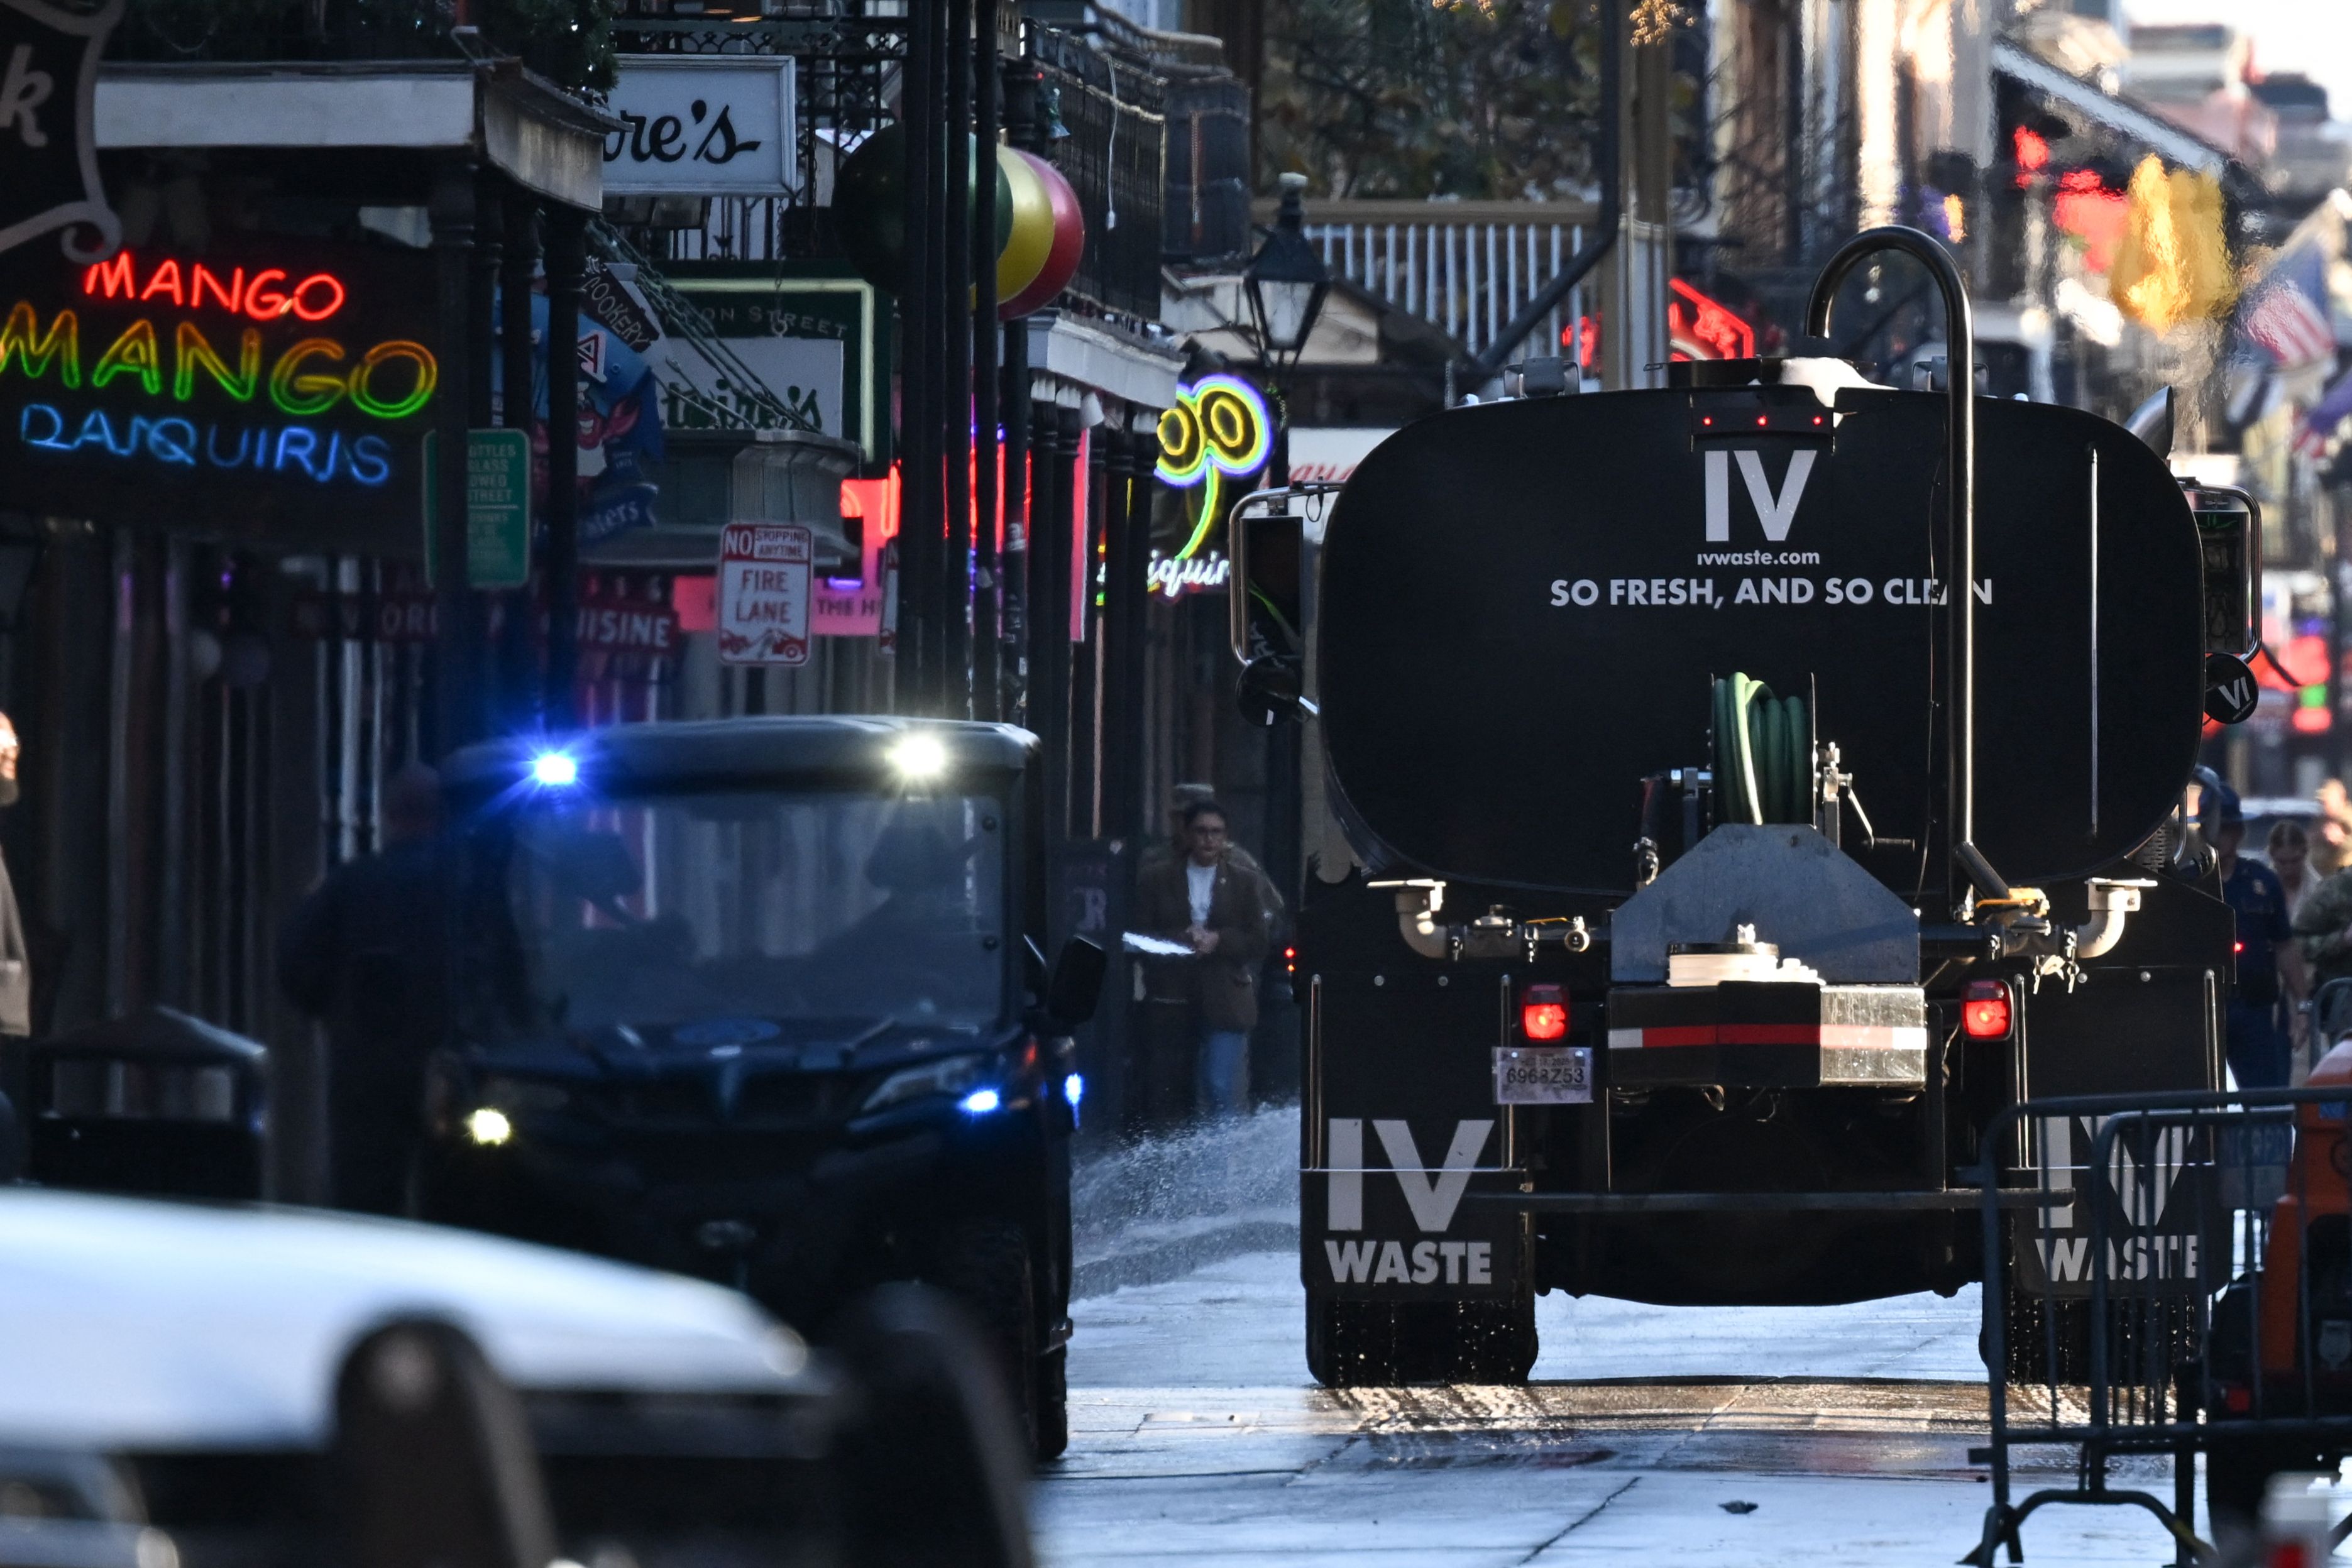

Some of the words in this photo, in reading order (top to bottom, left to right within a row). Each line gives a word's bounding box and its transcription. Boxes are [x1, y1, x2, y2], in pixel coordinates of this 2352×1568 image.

[85, 253, 344, 320] MANGO
[0, 301, 438, 417] MANGO
[1705, 449, 1818, 542] IV
[725, 529, 753, 556] NO
[1697, 549, 1820, 566] ivwaste.com
[742, 569, 789, 593] FIRE
[1550, 579, 1598, 606] SO
[1610, 579, 1725, 610] FRESH,
[1734, 578, 1814, 605] AND
[1824, 578, 1874, 605] SO
[1884, 578, 1992, 605] CLEN
[735, 600, 791, 624] LANE
[1327, 1117, 1495, 1232] IV
[1323, 1239, 1493, 1285] WASTE
